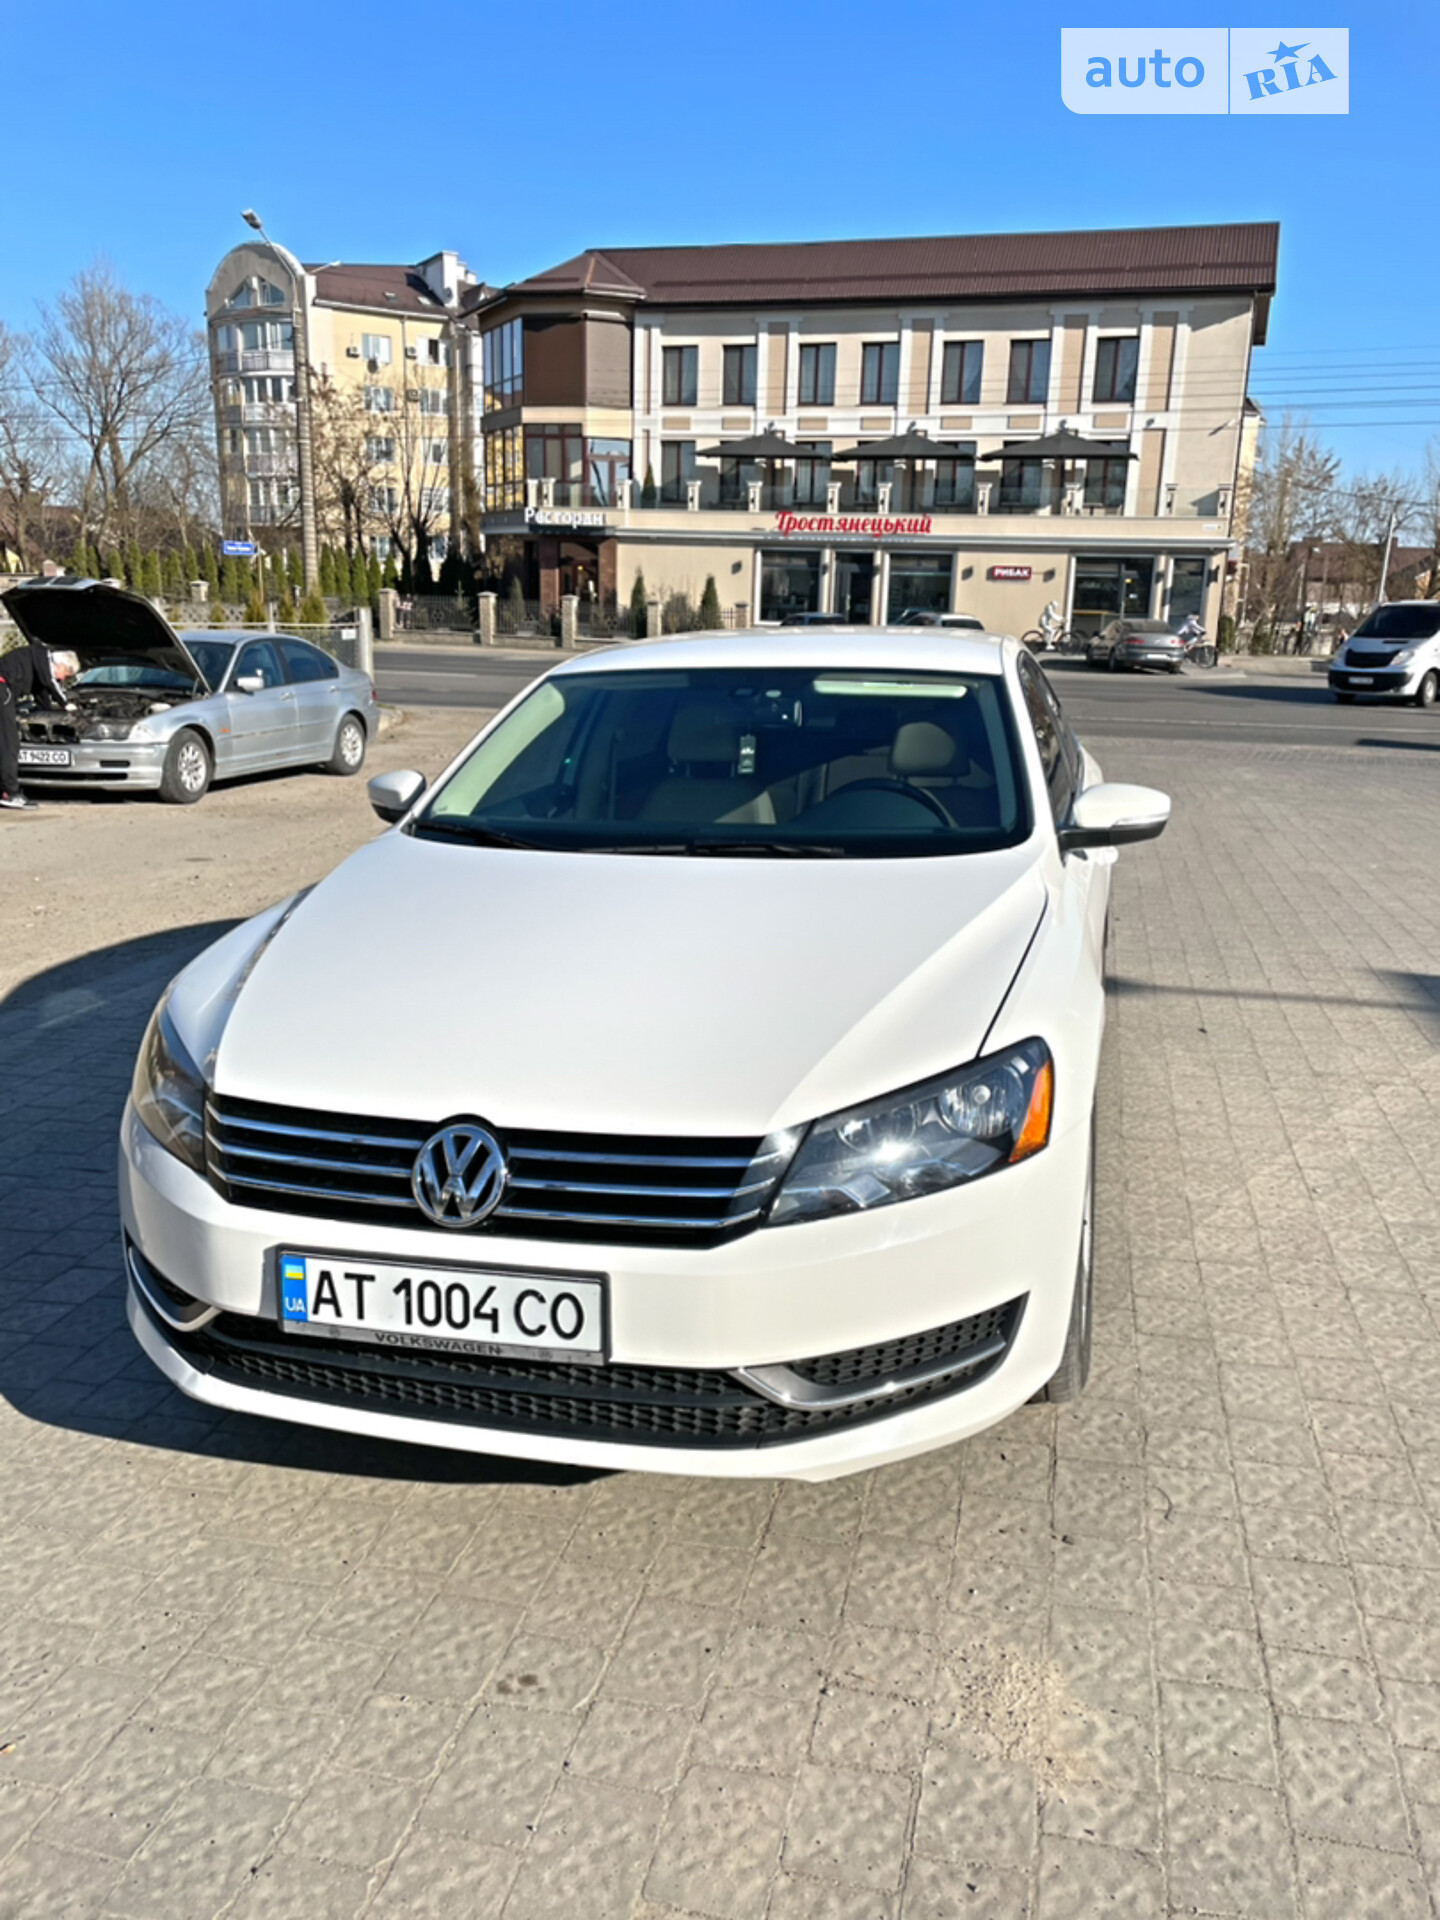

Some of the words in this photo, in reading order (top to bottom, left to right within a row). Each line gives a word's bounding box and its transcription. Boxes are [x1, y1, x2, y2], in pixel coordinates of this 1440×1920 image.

[524, 506, 605, 529] Ресторан
[775, 510, 932, 537] Тростянецький
[285, 1297, 306, 1313] UA
[312, 1270, 376, 1320] AT
[392, 1278, 499, 1334] 1004
[513, 1288, 585, 1340] CO
[374, 1332, 501, 1354] VOLKSWAGEN
